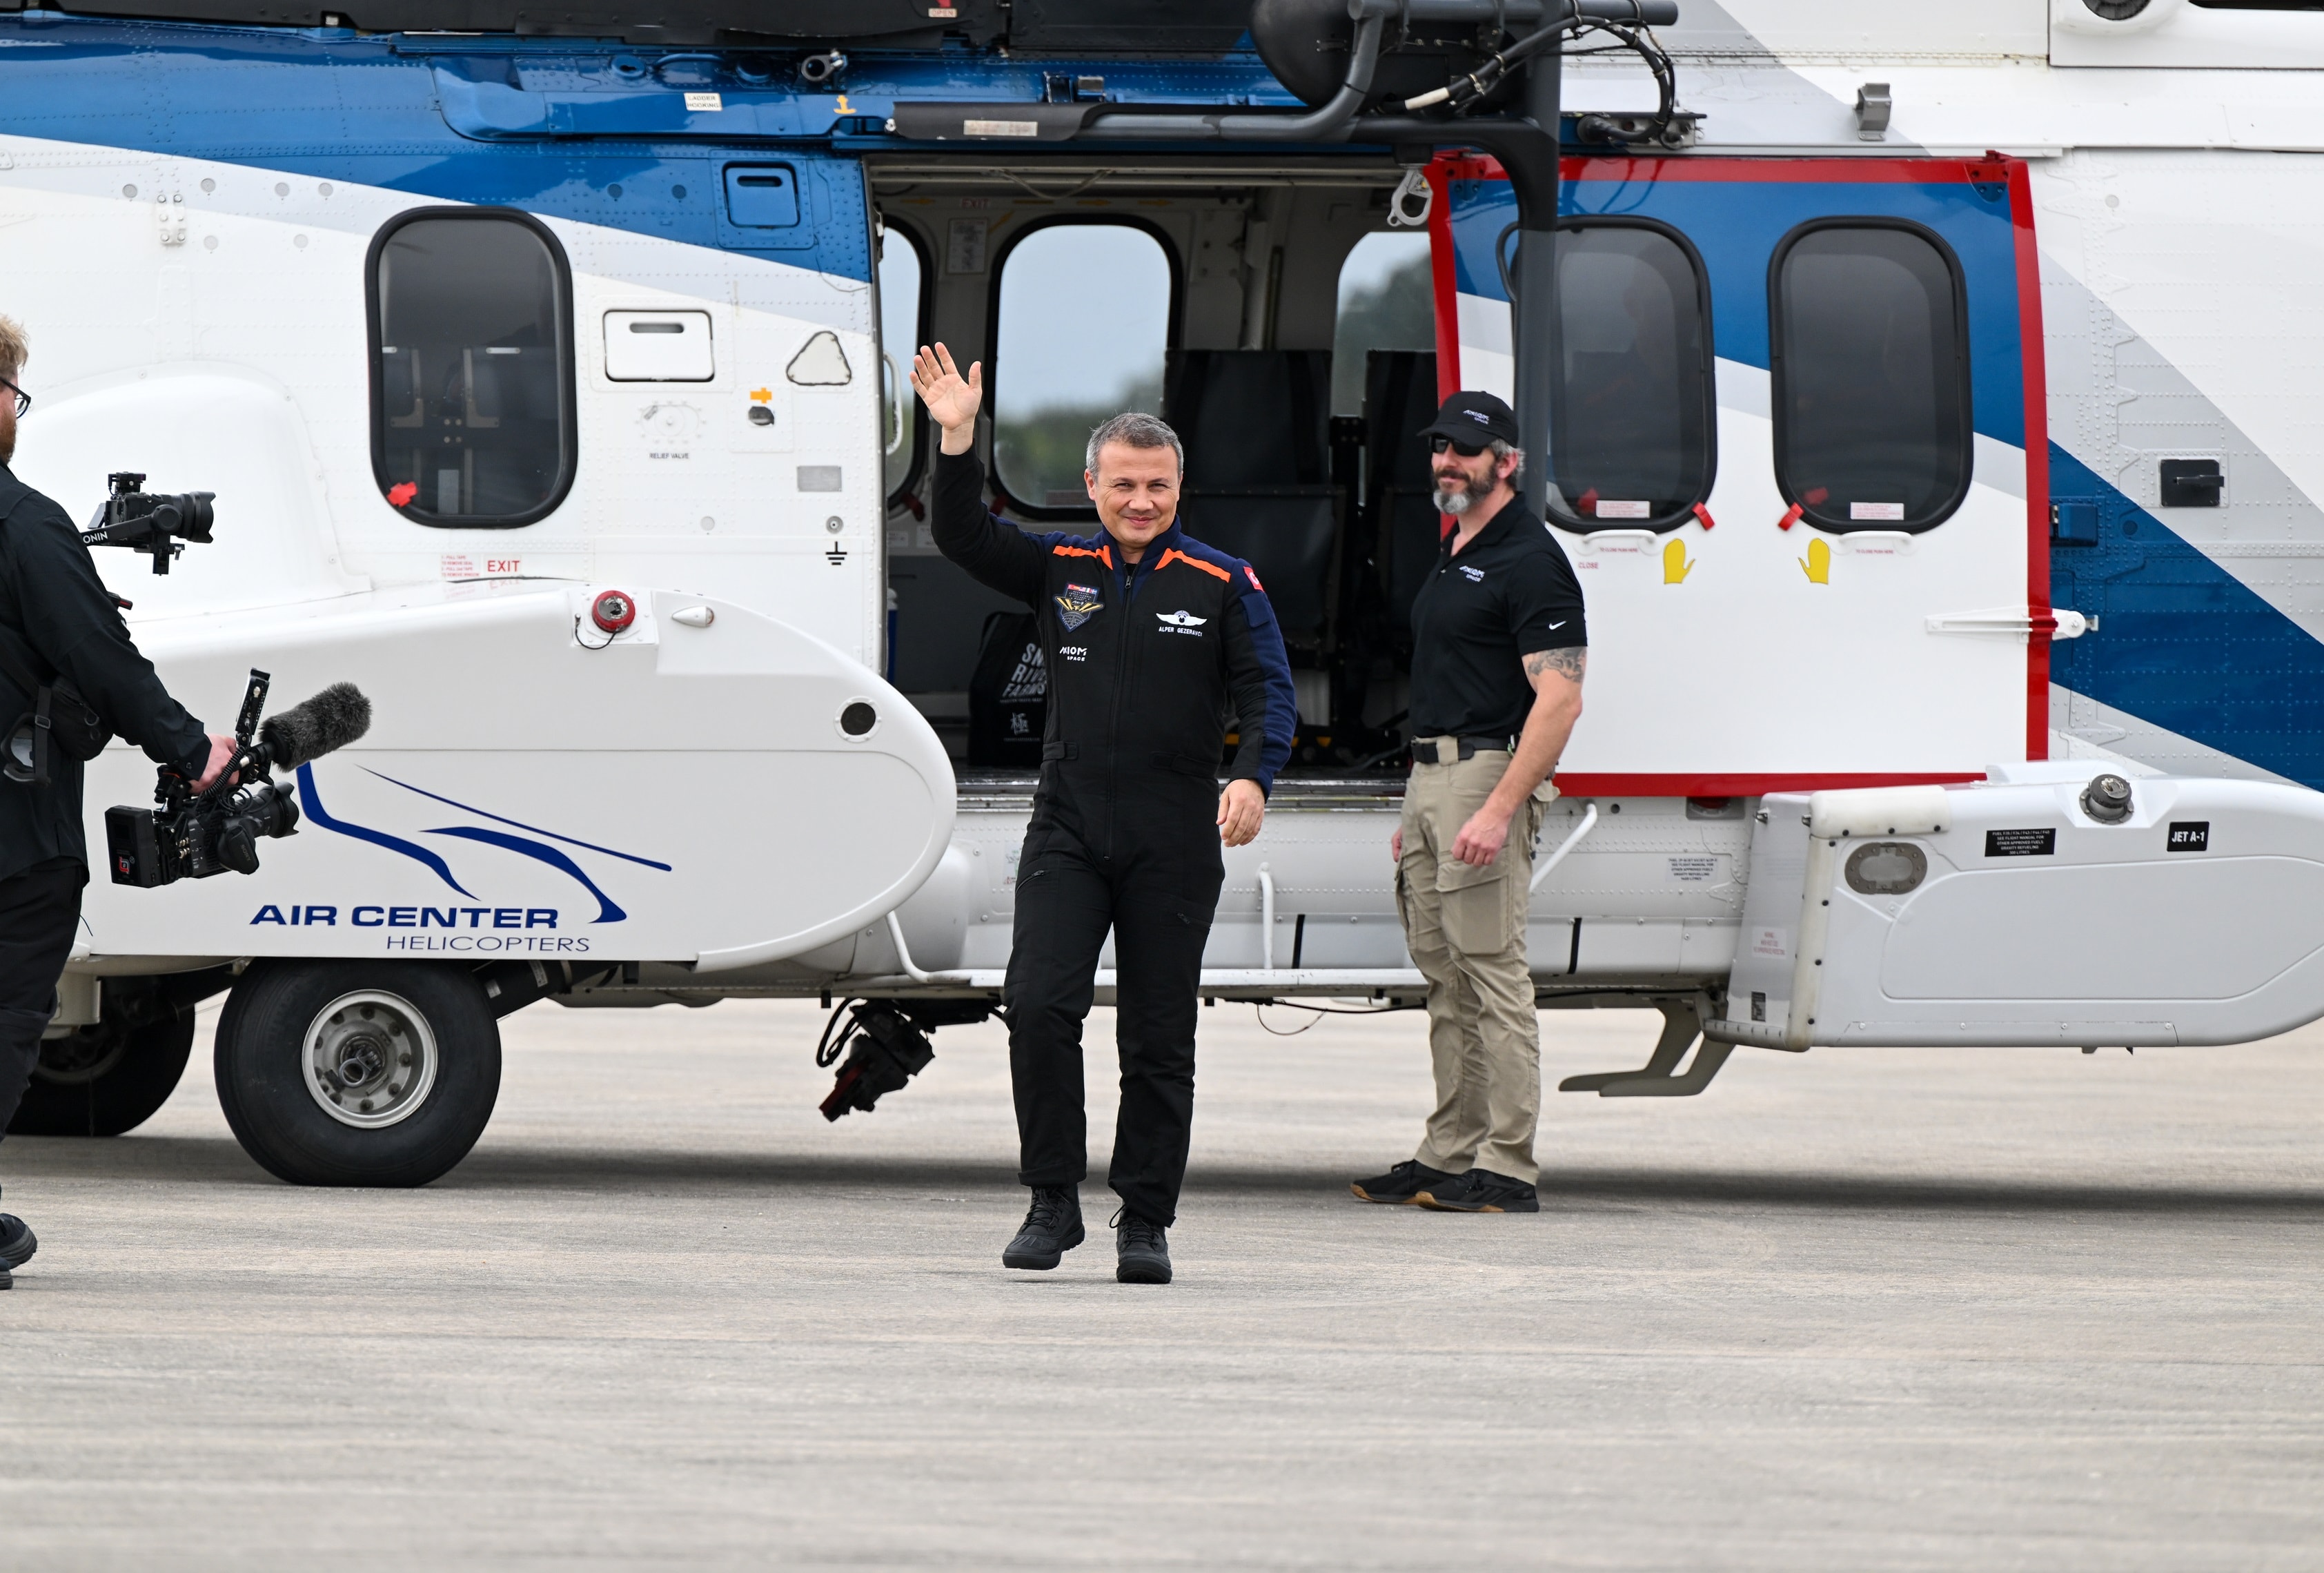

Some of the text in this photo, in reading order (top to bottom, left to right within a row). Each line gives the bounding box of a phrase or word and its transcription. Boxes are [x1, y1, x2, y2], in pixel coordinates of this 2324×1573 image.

[83, 531, 108, 544] ONIN
[488, 560, 521, 572] EXIT
[2172, 831, 2205, 842] JET A-1
[249, 905, 558, 929] AIR CENTER
[386, 936, 590, 952] HELICOPTERS
